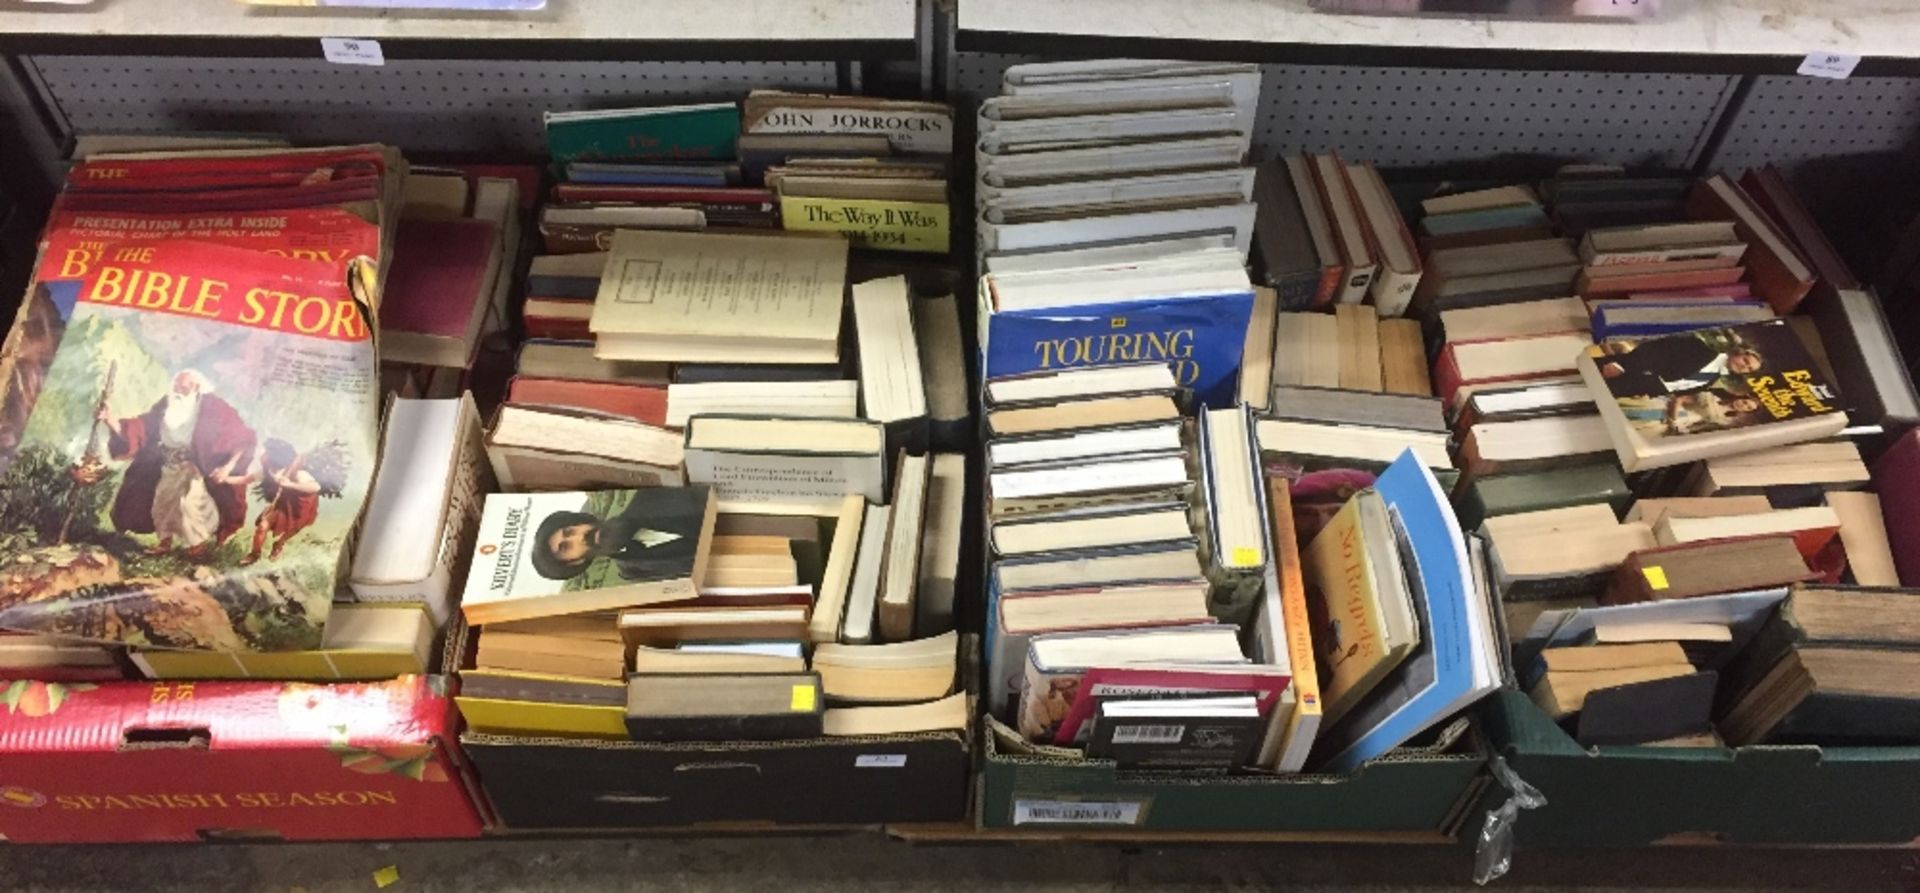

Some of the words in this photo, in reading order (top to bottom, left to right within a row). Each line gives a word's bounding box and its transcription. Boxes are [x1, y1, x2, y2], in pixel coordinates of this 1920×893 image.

[764, 112, 814, 127] OHN
[828, 114, 942, 132] JORROCKS
[73, 216, 181, 230] PRESENTATION
[188, 217, 233, 229] EXTRA
[240, 216, 288, 229] INSIDE
[804, 205, 842, 223] The
[842, 207, 882, 229] Way
[898, 210, 938, 228] Was
[114, 246, 156, 264] THE
[90, 266, 229, 317] BIBLE
[238, 287, 366, 338] STOR
[1034, 328, 1194, 368] TOURING
[1338, 524, 1356, 559] No
[1345, 563, 1375, 658] Regrets
[56, 794, 228, 810] SPANISH
[236, 791, 397, 808] SEASON
